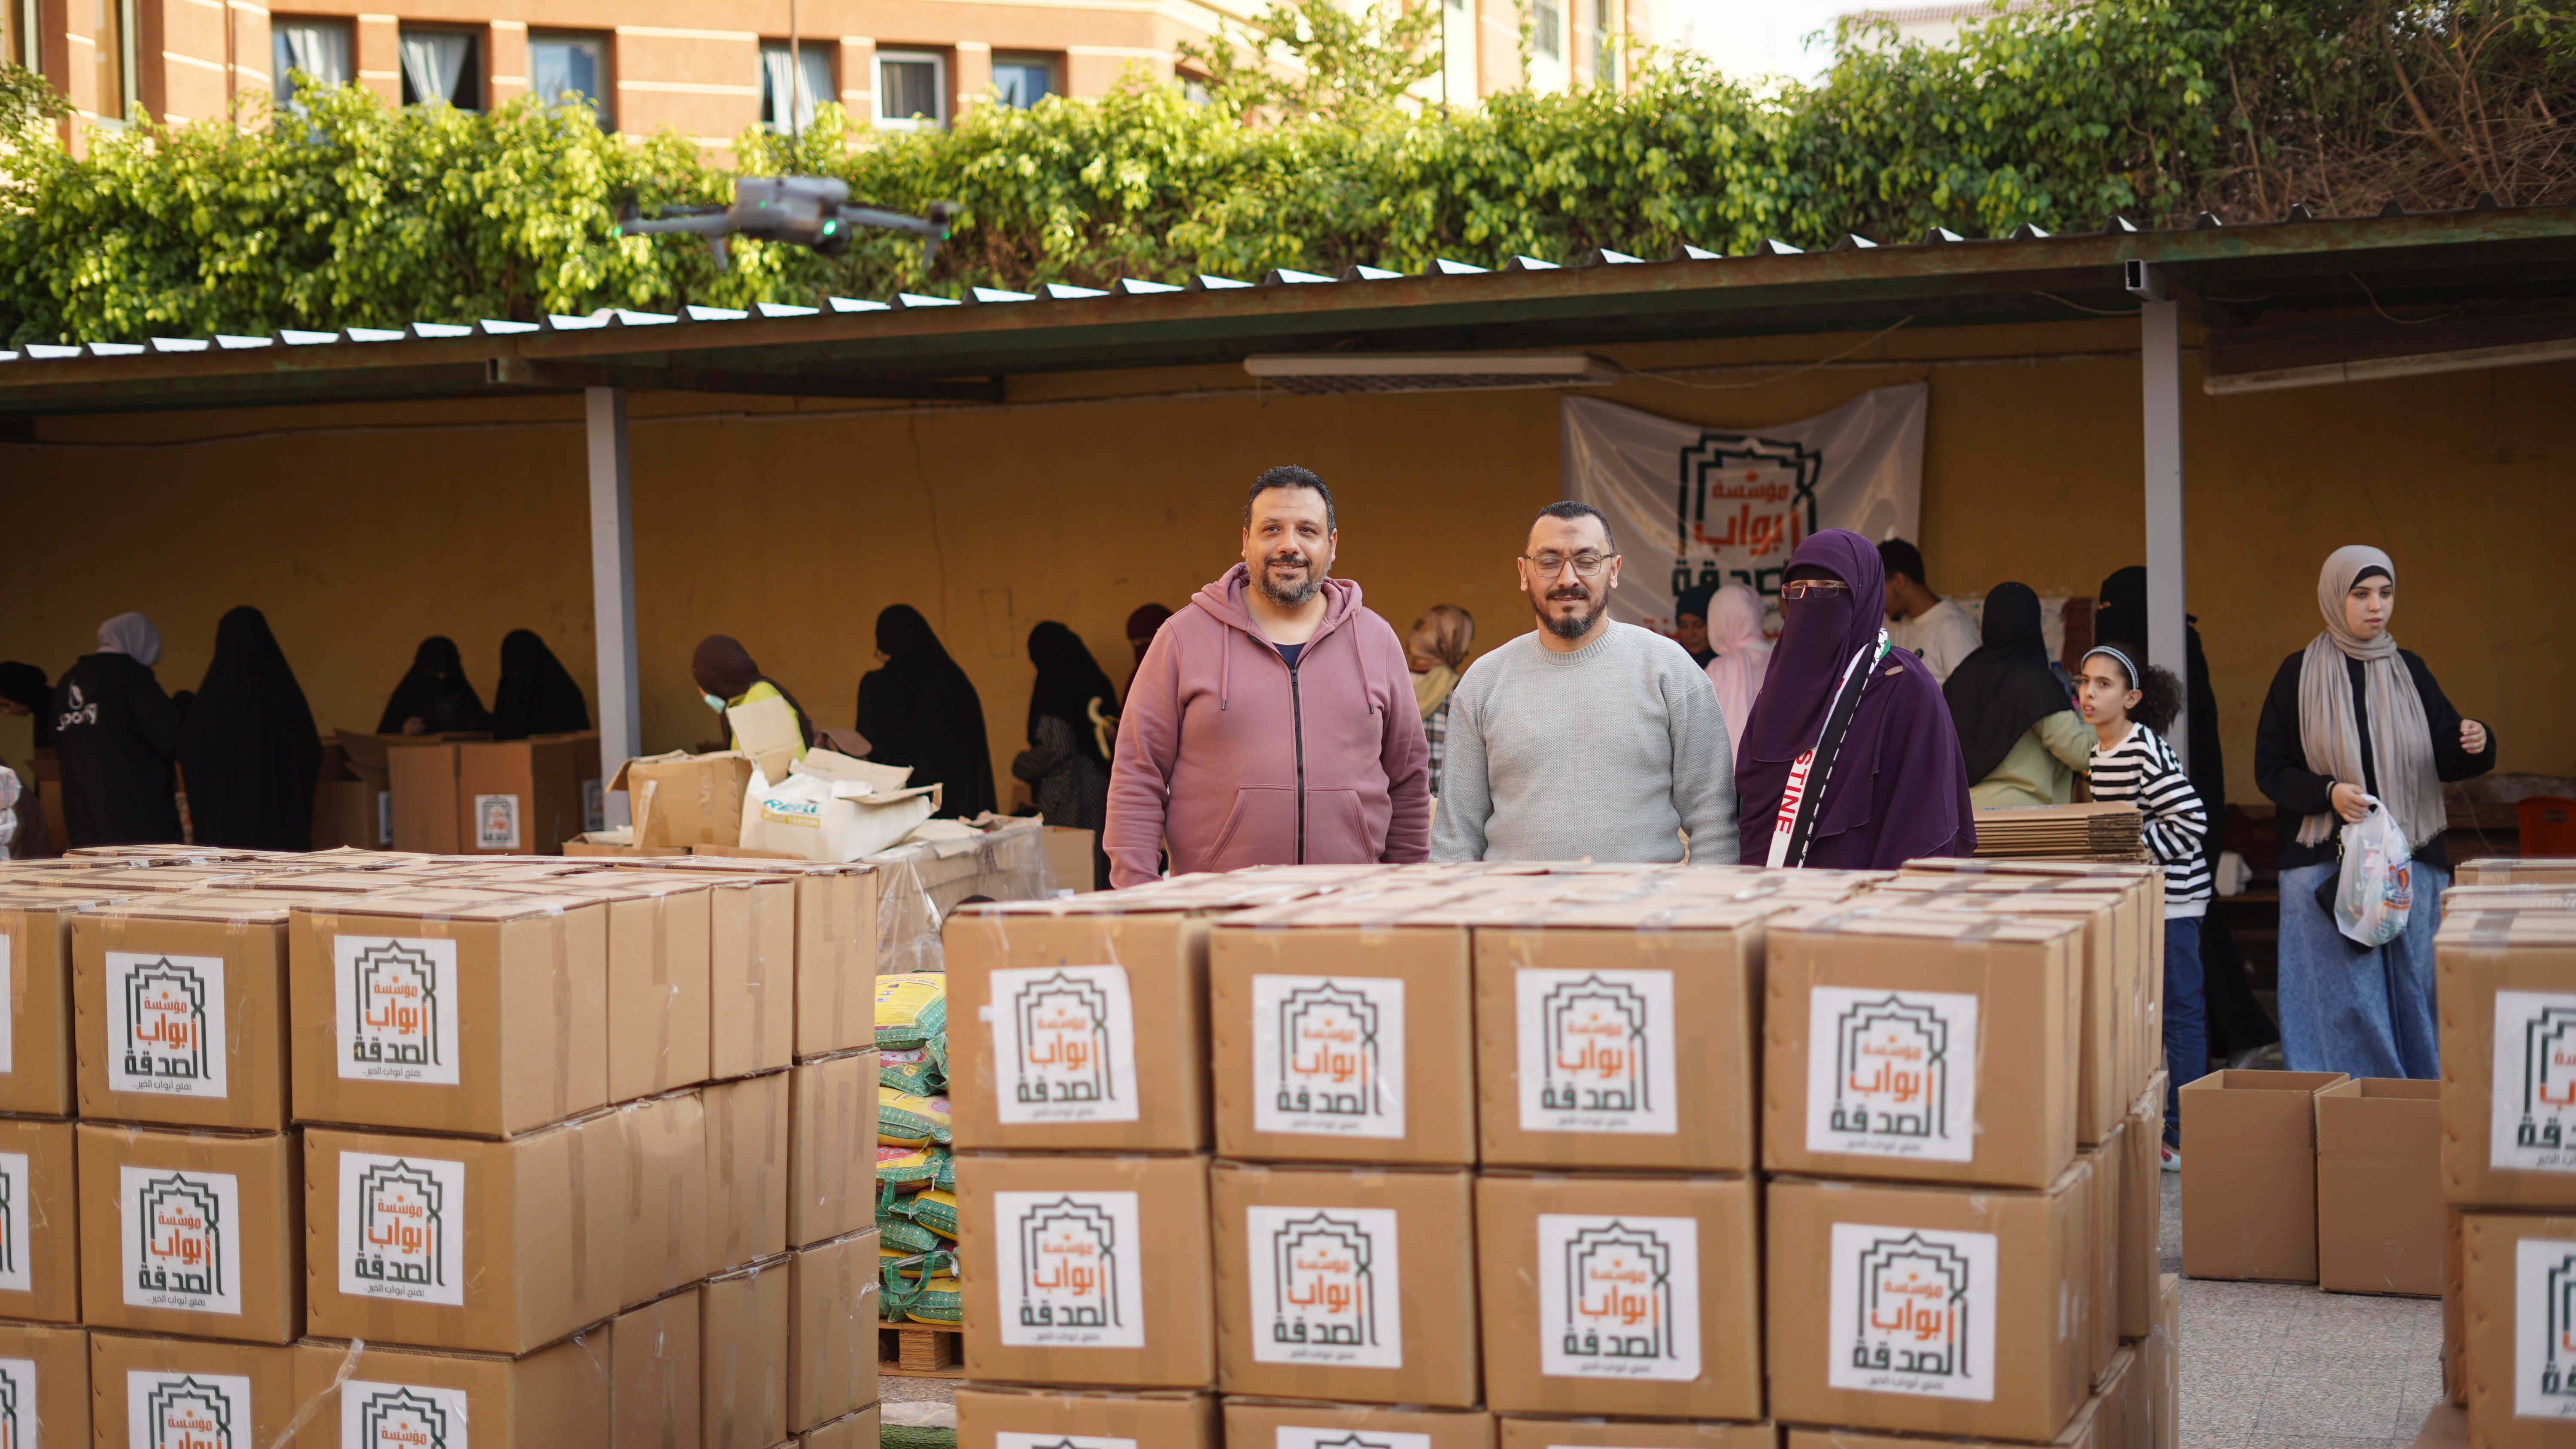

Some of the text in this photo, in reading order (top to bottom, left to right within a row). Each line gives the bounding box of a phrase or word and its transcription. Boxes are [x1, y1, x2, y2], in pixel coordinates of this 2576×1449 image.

[1712, 479, 1789, 503] مؤسسة
[1774, 750, 1813, 834] STINE
[145, 997, 187, 1014] مؤسسة
[374, 981, 417, 998] مؤسسة
[137, 1013, 197, 1051] أبواب
[366, 998, 427, 1036] أبواب
[125, 1049, 213, 1079] الصدقة
[354, 1036, 443, 1065] الصدقة
[154, 1079, 173, 1091] أبواب
[383, 1066, 402, 1078] أبواب
[1016, 1069, 1118, 1104] الصدقة
[1276, 1084, 1385, 1116] الصدقة
[1541, 1079, 1655, 1112] الصدقة
[1830, 1102, 1951, 1139] الصدقة
[159, 1212, 201, 1230] مؤسسة
[378, 1199, 422, 1218] مؤسسة
[151, 1228, 211, 1267] أبواب
[368, 1216, 431, 1257] أبواب
[139, 1264, 226, 1296] الصدقة
[355, 1252, 446, 1286] الصدقة
[167, 1295, 187, 1307] أبواب
[384, 1285, 405, 1296] أبواب
[1020, 1295, 1124, 1328] الصدقة
[1273, 1314, 1382, 1347] الصدقة
[1563, 1326, 1679, 1359] الصدقة
[1853, 1339, 1973, 1378] الصدقة
[168, 1415, 212, 1432] مؤسسة
[382, 1426, 427, 1445] مؤسسة
